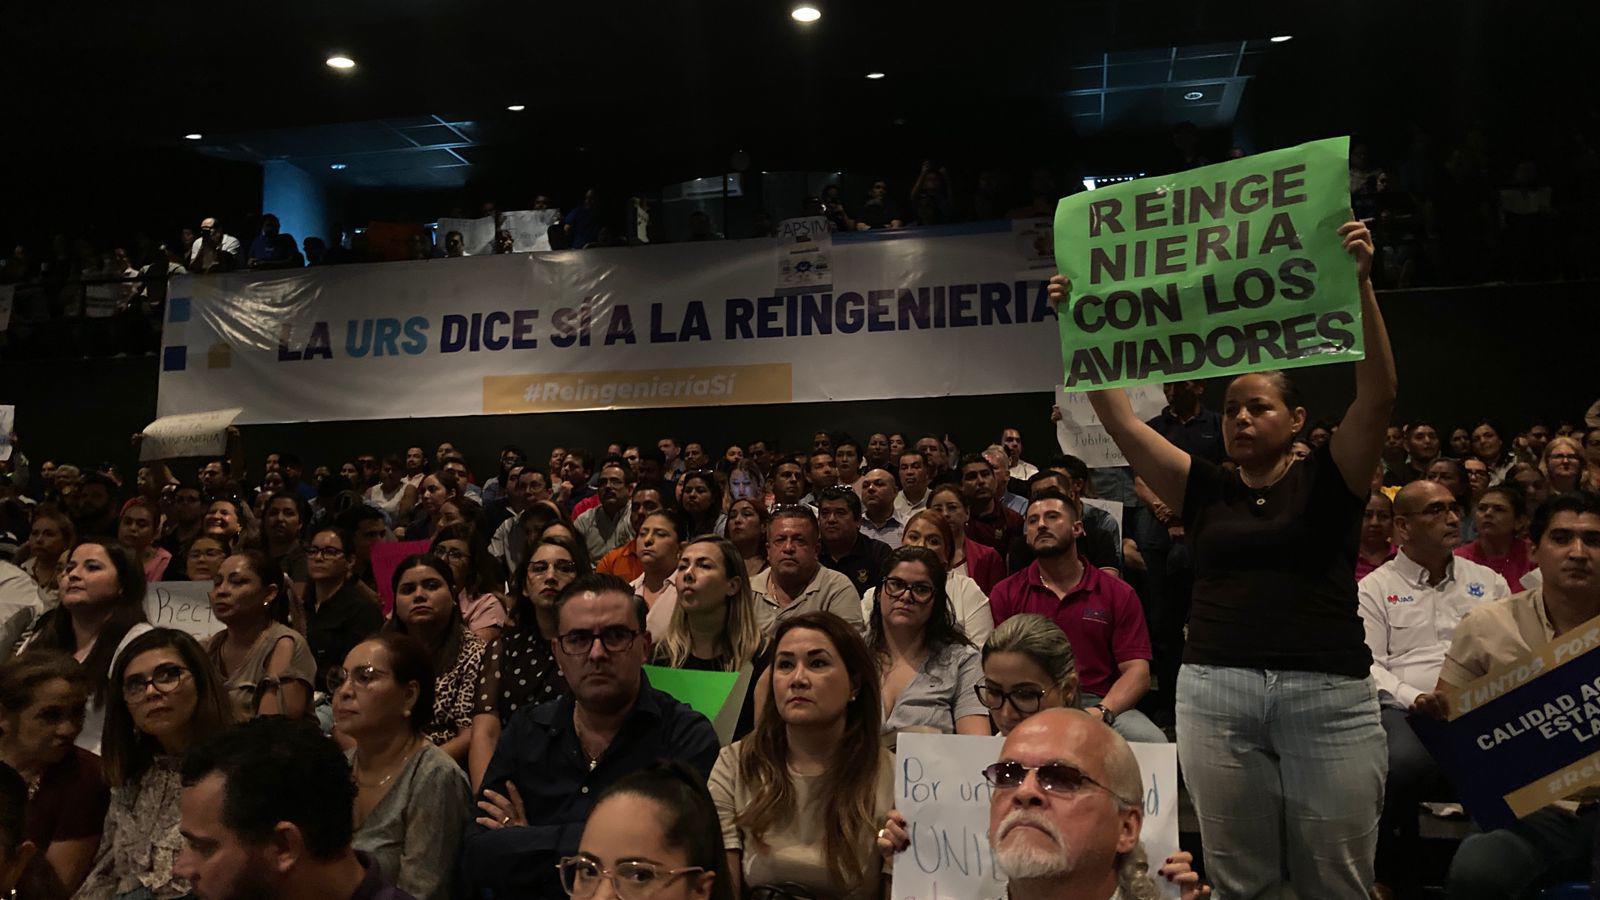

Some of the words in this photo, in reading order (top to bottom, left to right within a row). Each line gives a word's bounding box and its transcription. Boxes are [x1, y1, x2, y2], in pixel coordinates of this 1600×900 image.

[1089, 163, 1308, 238] REINGE
[1090, 212, 1303, 285] NIERIA
[1073, 282, 1183, 333] CON
[1202, 257, 1318, 315] LOS
[278, 321, 333, 361] LA
[345, 316, 430, 359] URS
[440, 309, 539, 353] DICE
[550, 296, 604, 348] SÍ
[604, 304, 636, 346] A
[650, 301, 712, 343] LA
[1065, 310, 1355, 388] AVIADORES
[156, 587, 213, 624] Rect
[1476, 694, 1576, 751] CALIDAD
[1538, 696, 1600, 740] ESTA
[903, 756, 943, 803] Por
[959, 779, 992, 802] un
